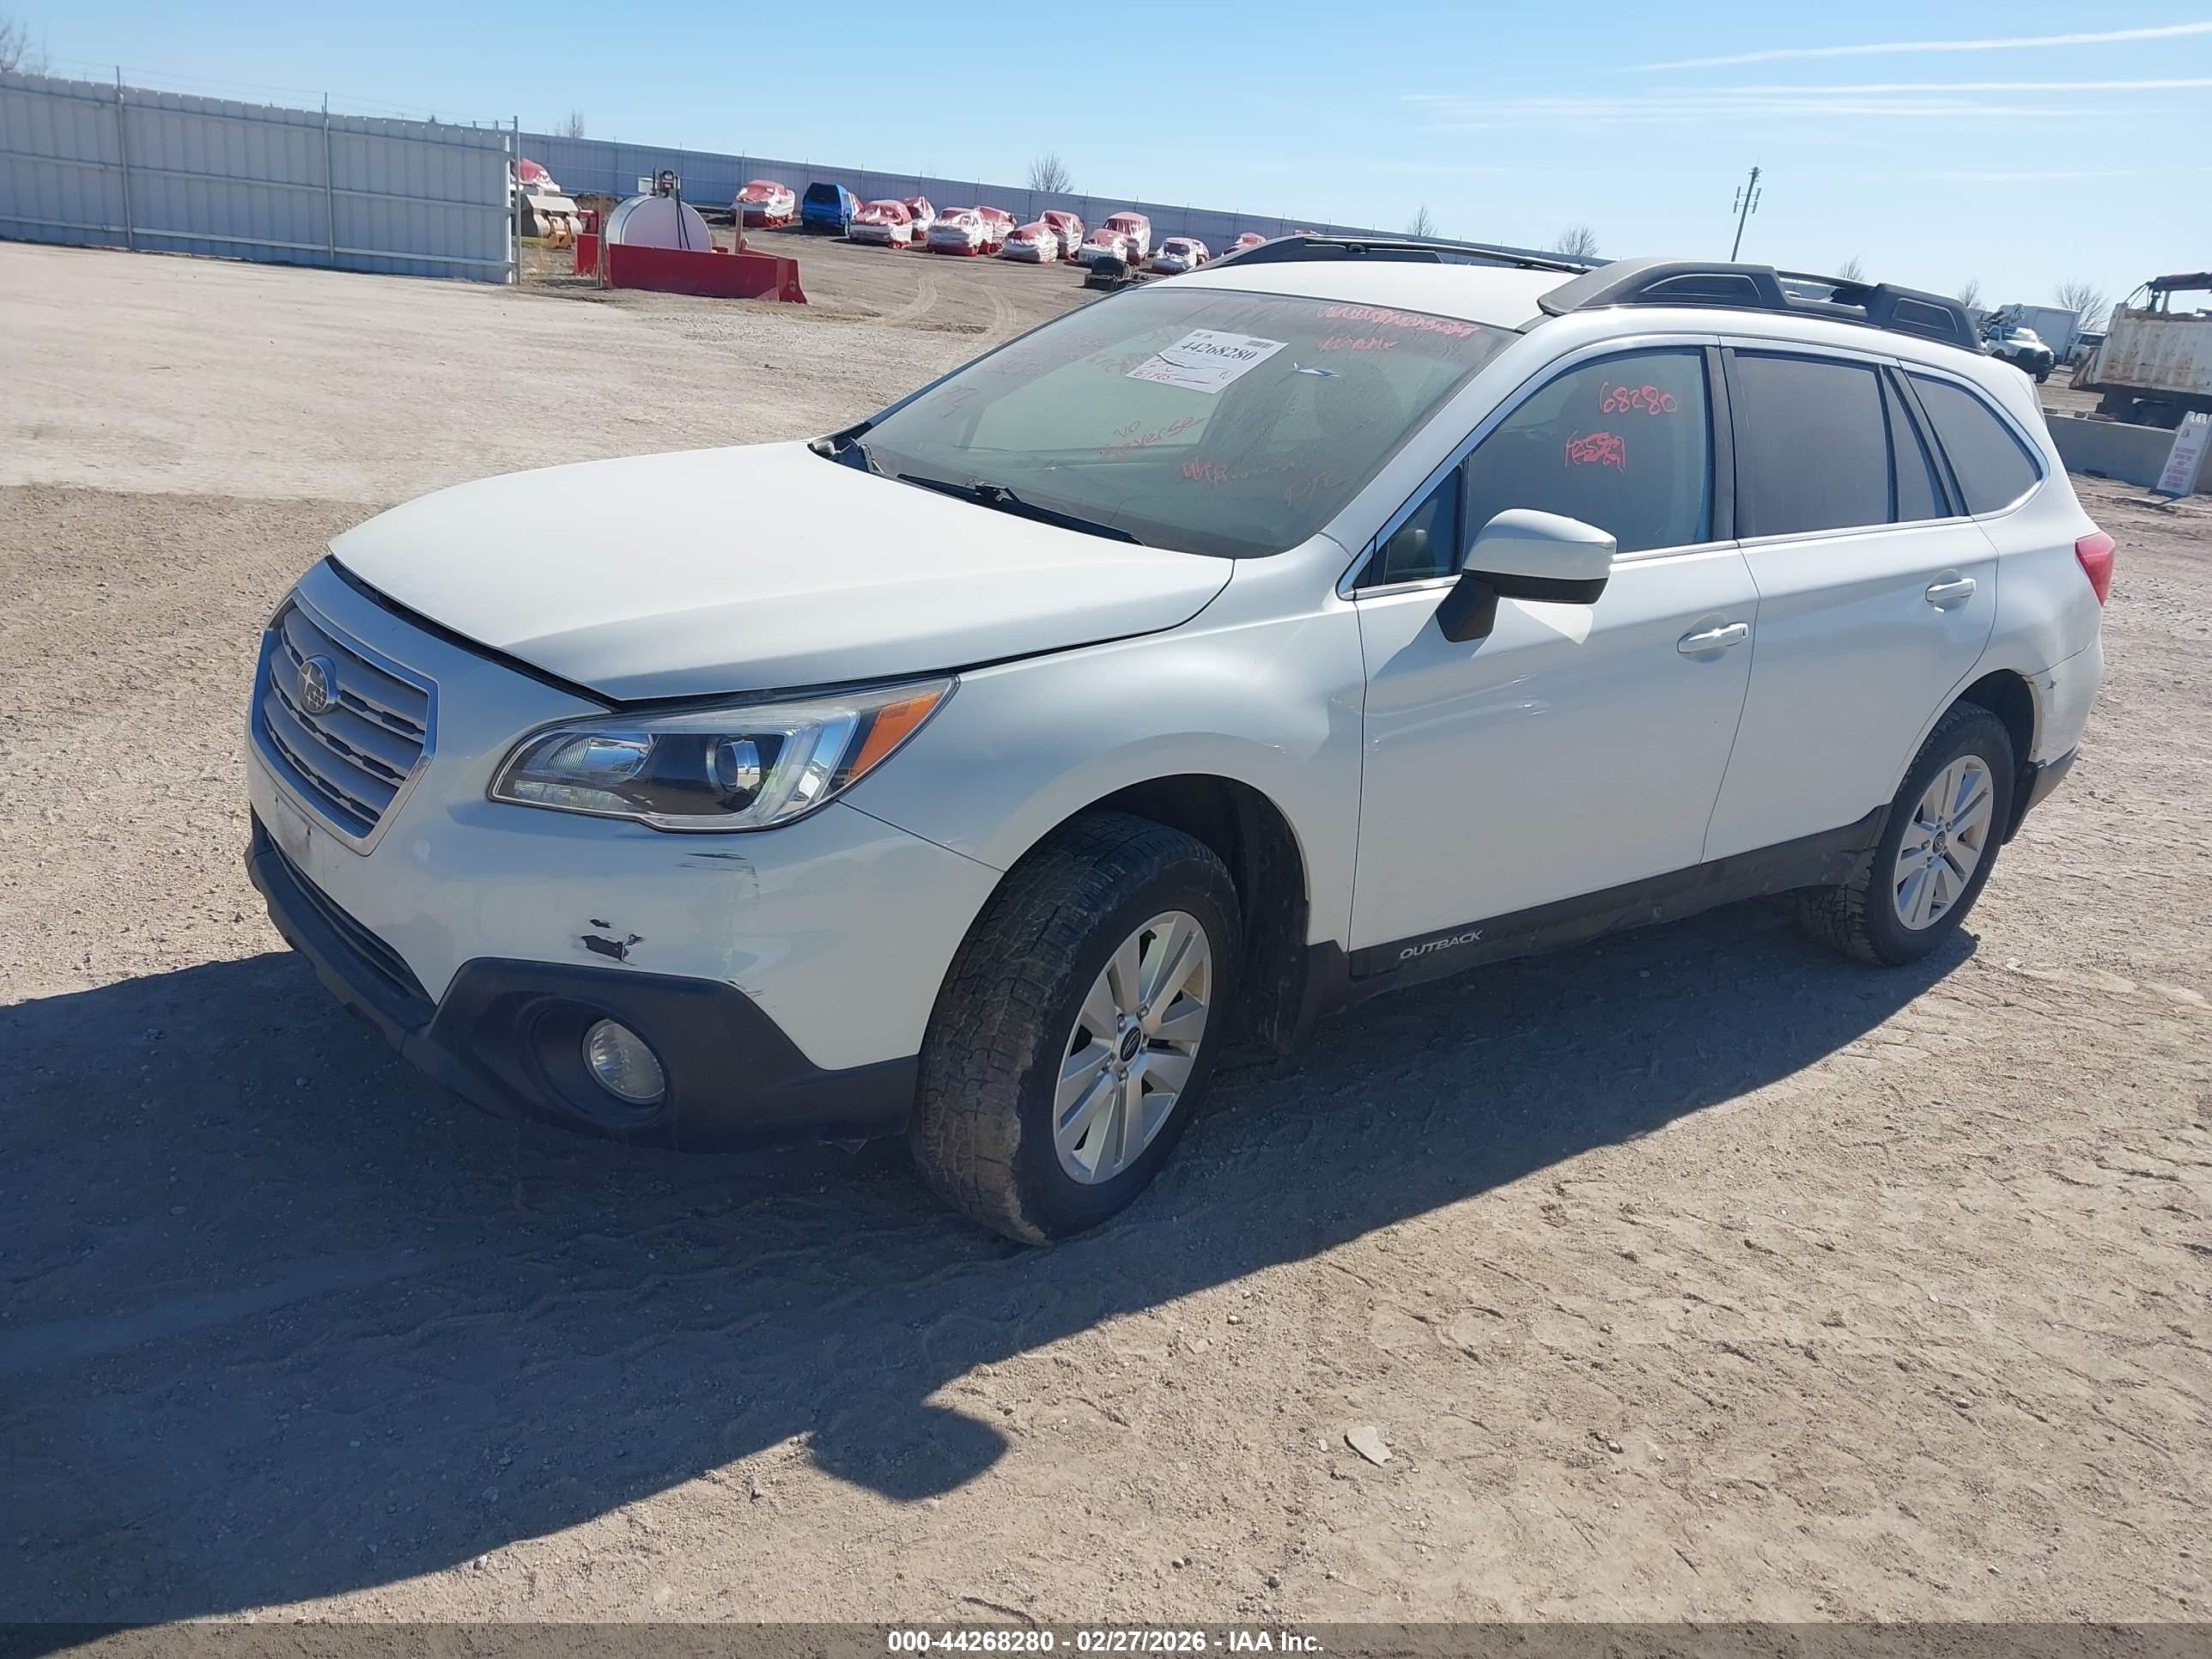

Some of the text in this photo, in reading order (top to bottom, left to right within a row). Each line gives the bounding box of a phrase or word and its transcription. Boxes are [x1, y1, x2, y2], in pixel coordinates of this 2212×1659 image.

[1181, 342, 1258, 362] 44268280
[1600, 382, 1678, 416] 68280
[1400, 930, 1483, 959] OUTBACK
